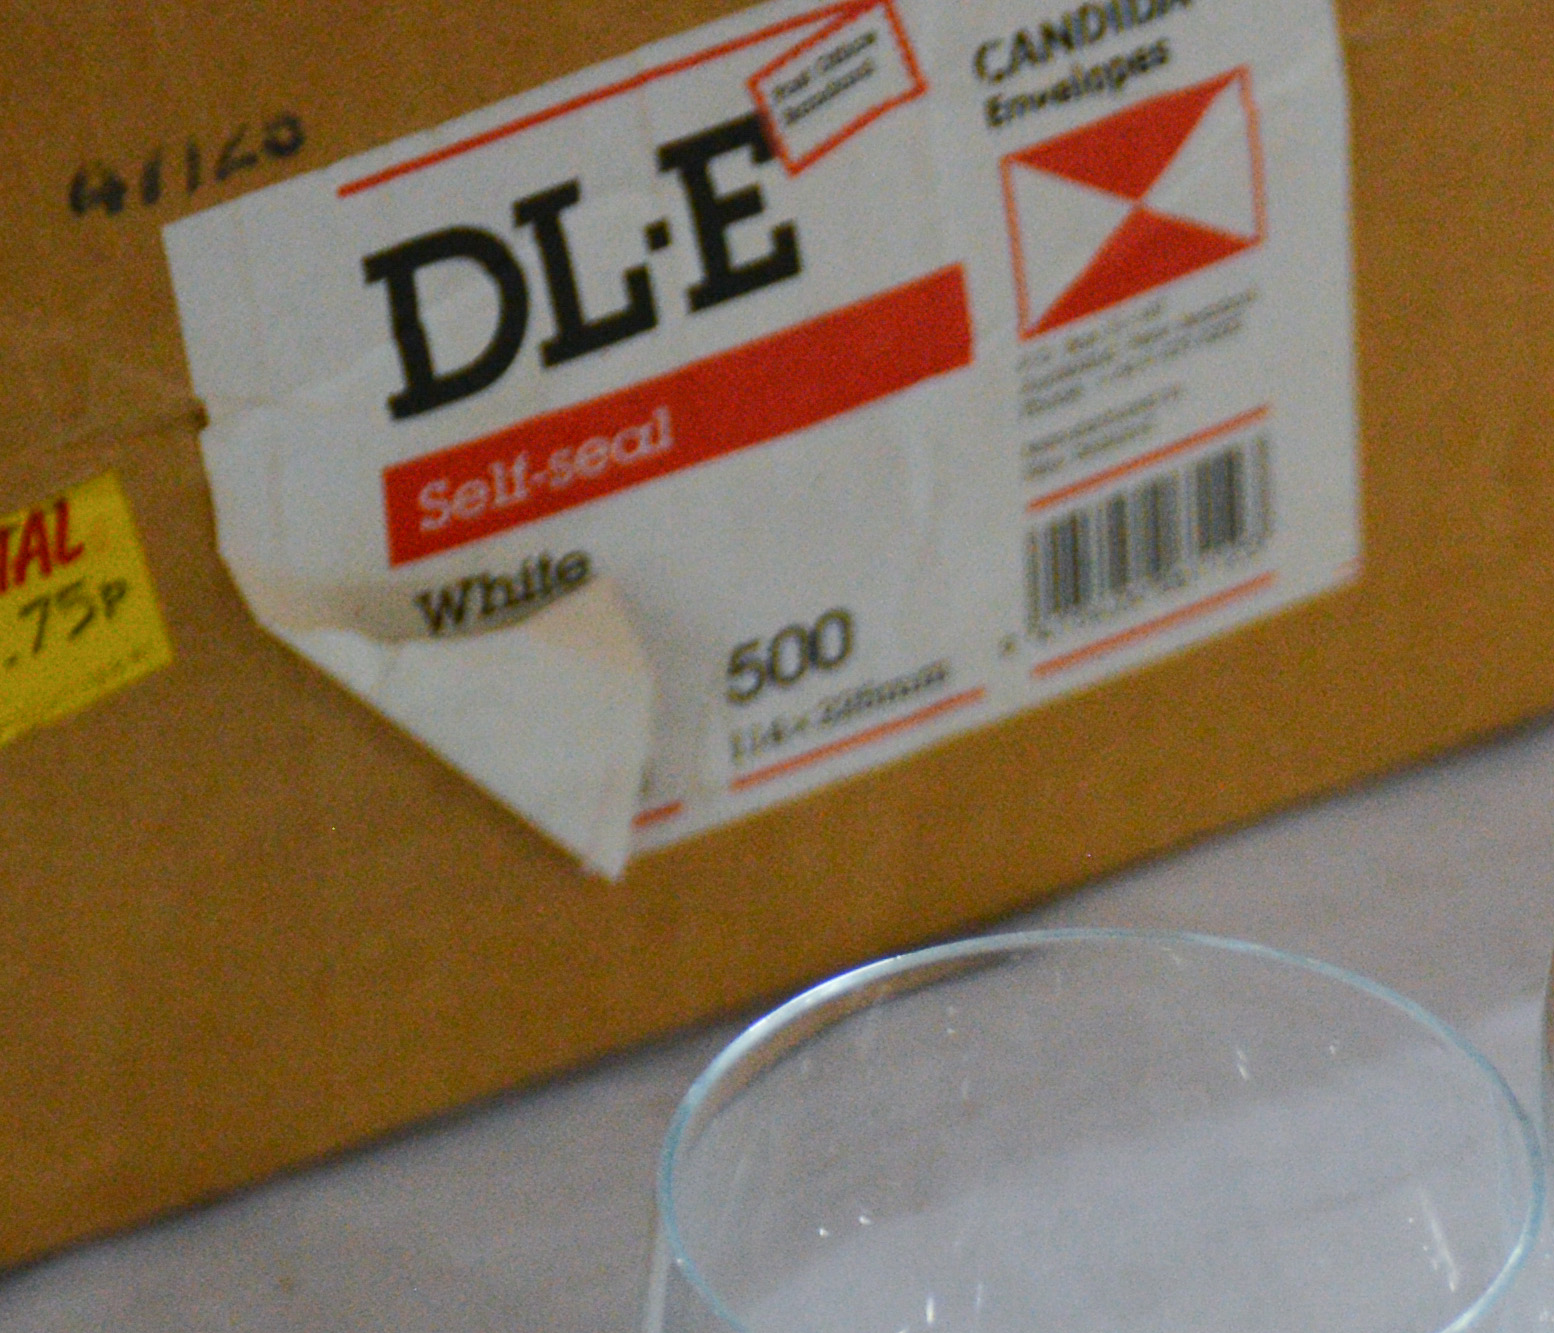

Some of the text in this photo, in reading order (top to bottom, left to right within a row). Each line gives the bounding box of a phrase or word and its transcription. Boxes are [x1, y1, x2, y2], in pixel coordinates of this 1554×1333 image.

[972, 0, 1192, 84] CANDID
[984, 37, 1171, 128] Envelopes
[418, 404, 676, 533] Self-seal
[414, 551, 591, 639] White
[727, 608, 853, 704] 500
